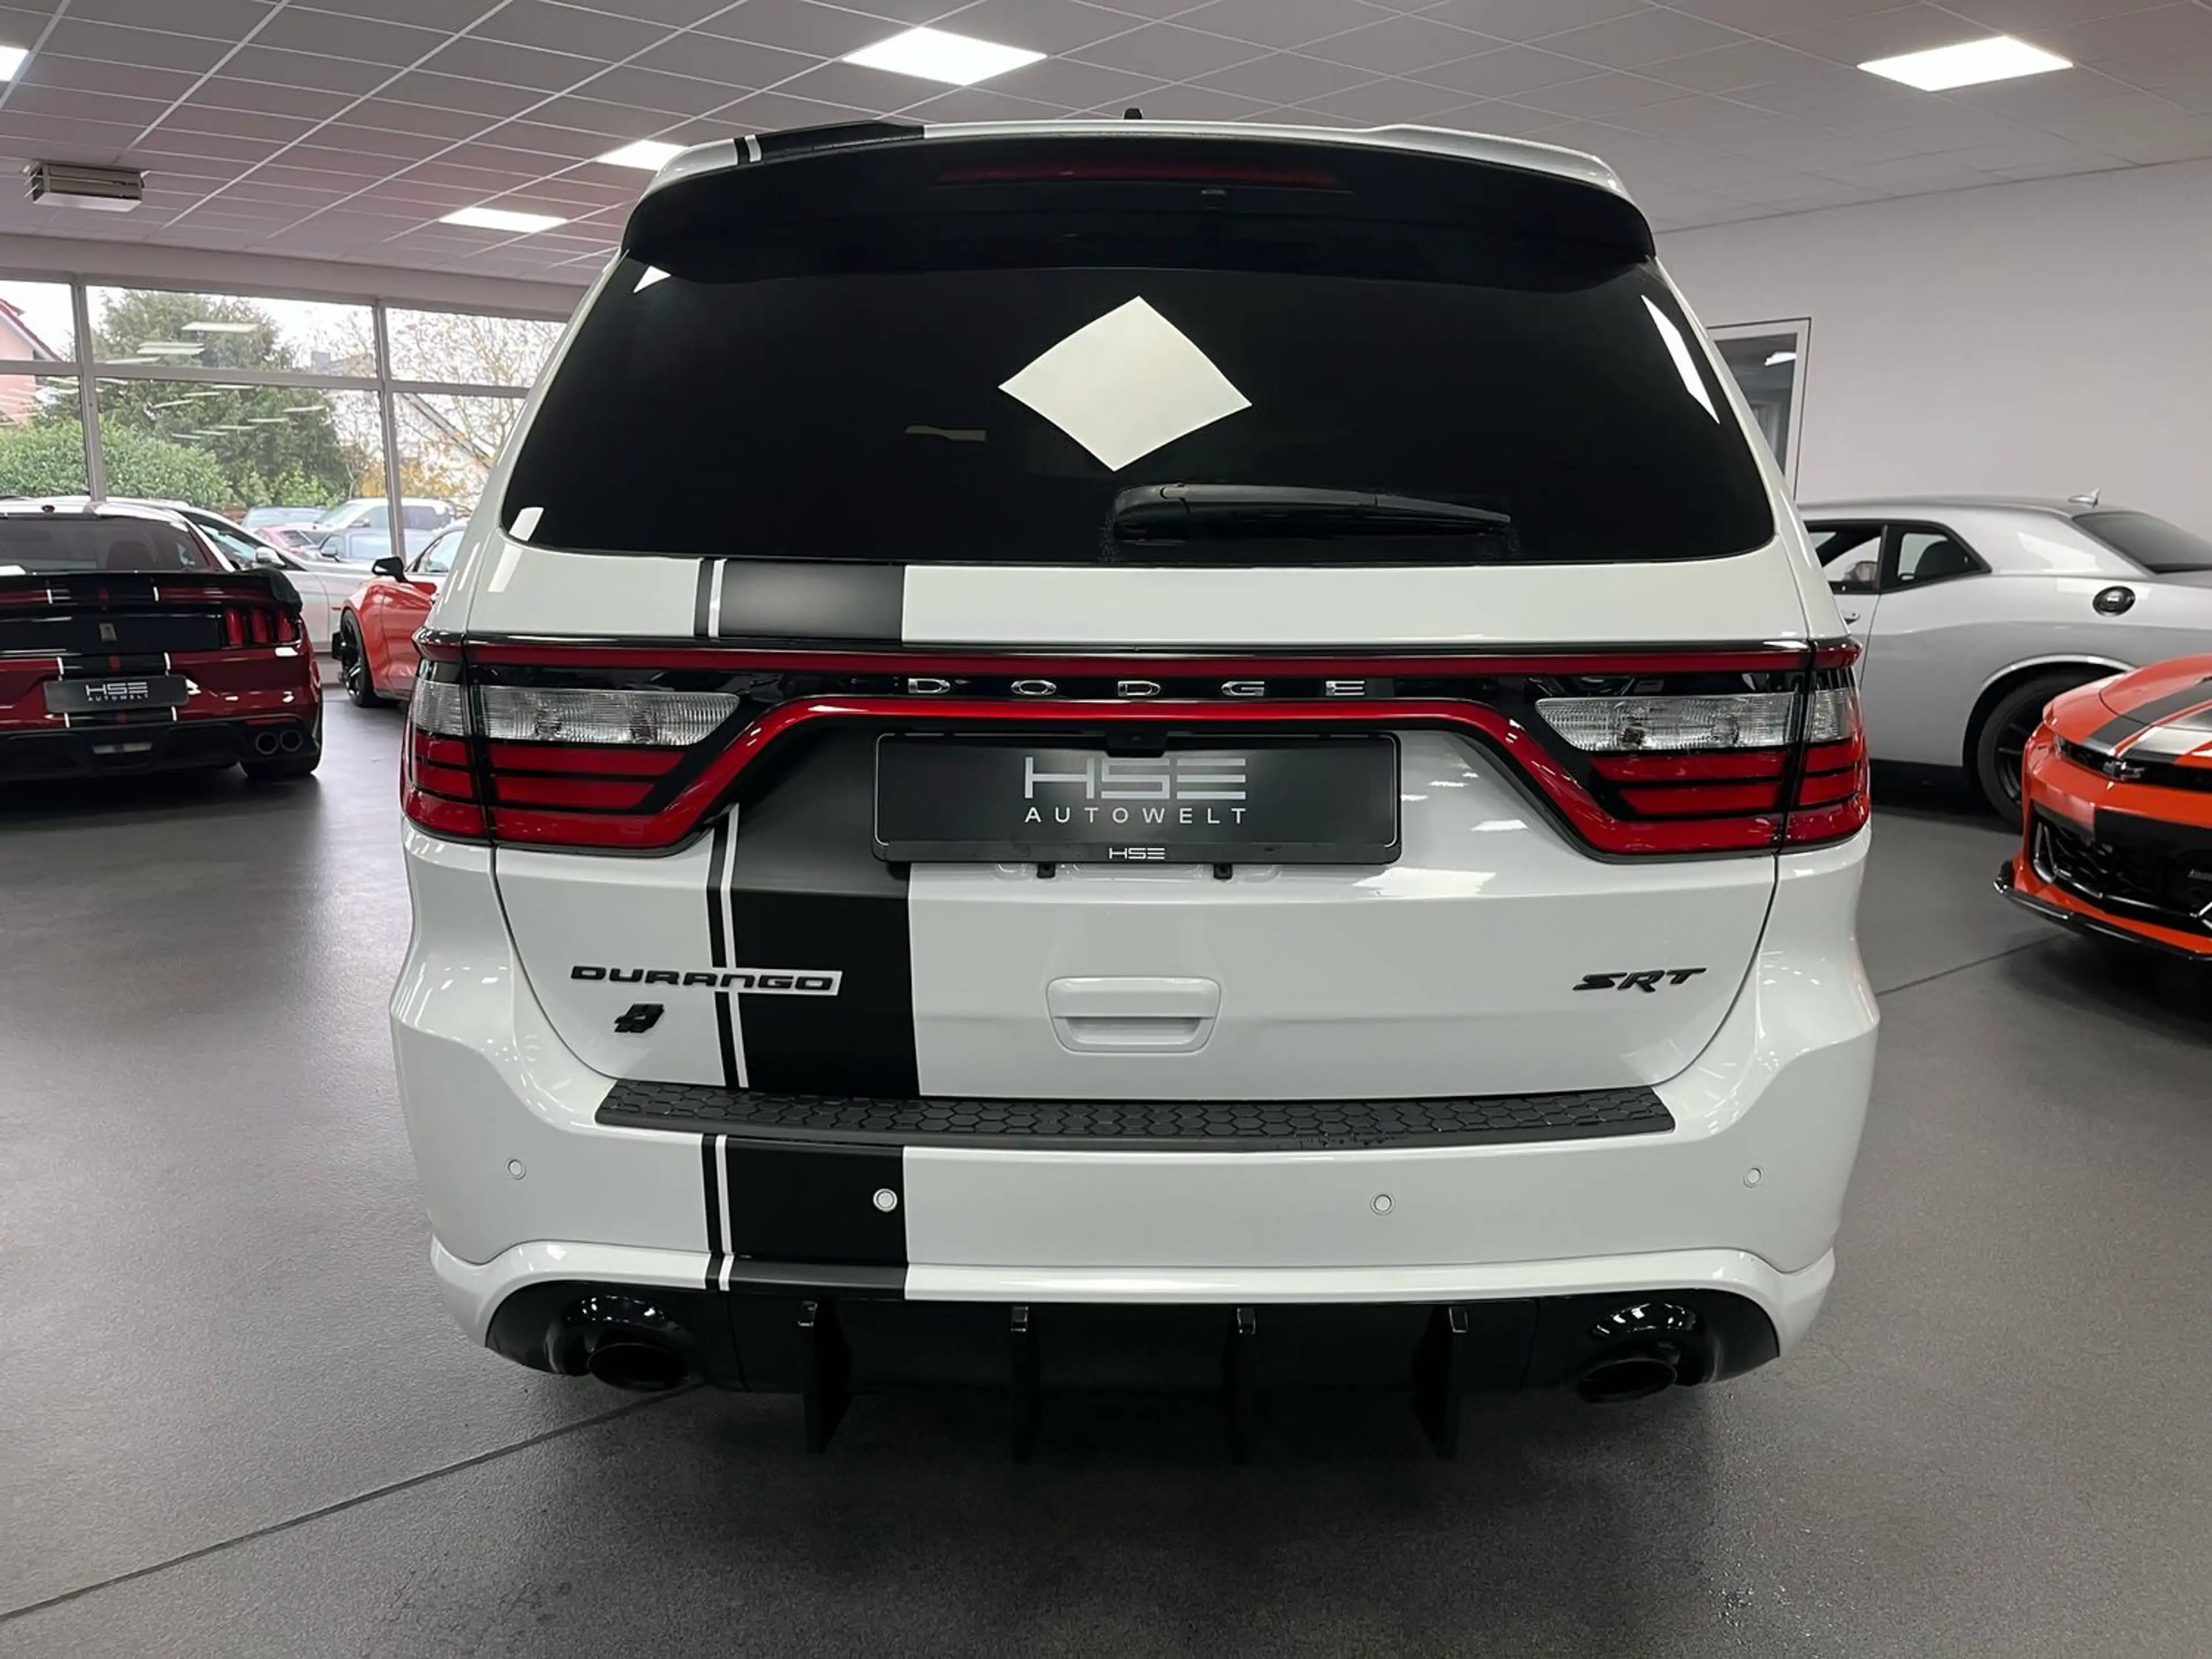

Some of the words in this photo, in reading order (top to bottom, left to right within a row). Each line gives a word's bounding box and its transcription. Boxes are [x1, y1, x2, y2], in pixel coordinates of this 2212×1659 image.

[85, 681, 148, 696] HSE
[907, 677, 1365, 696] DODGE
[1025, 756, 1246, 800] HSE
[1025, 806, 1246, 824] AUTOWELT
[1108, 847, 1165, 859] HSE
[571, 966, 834, 990] DURANGO
[1572, 967, 1707, 993] SRT
